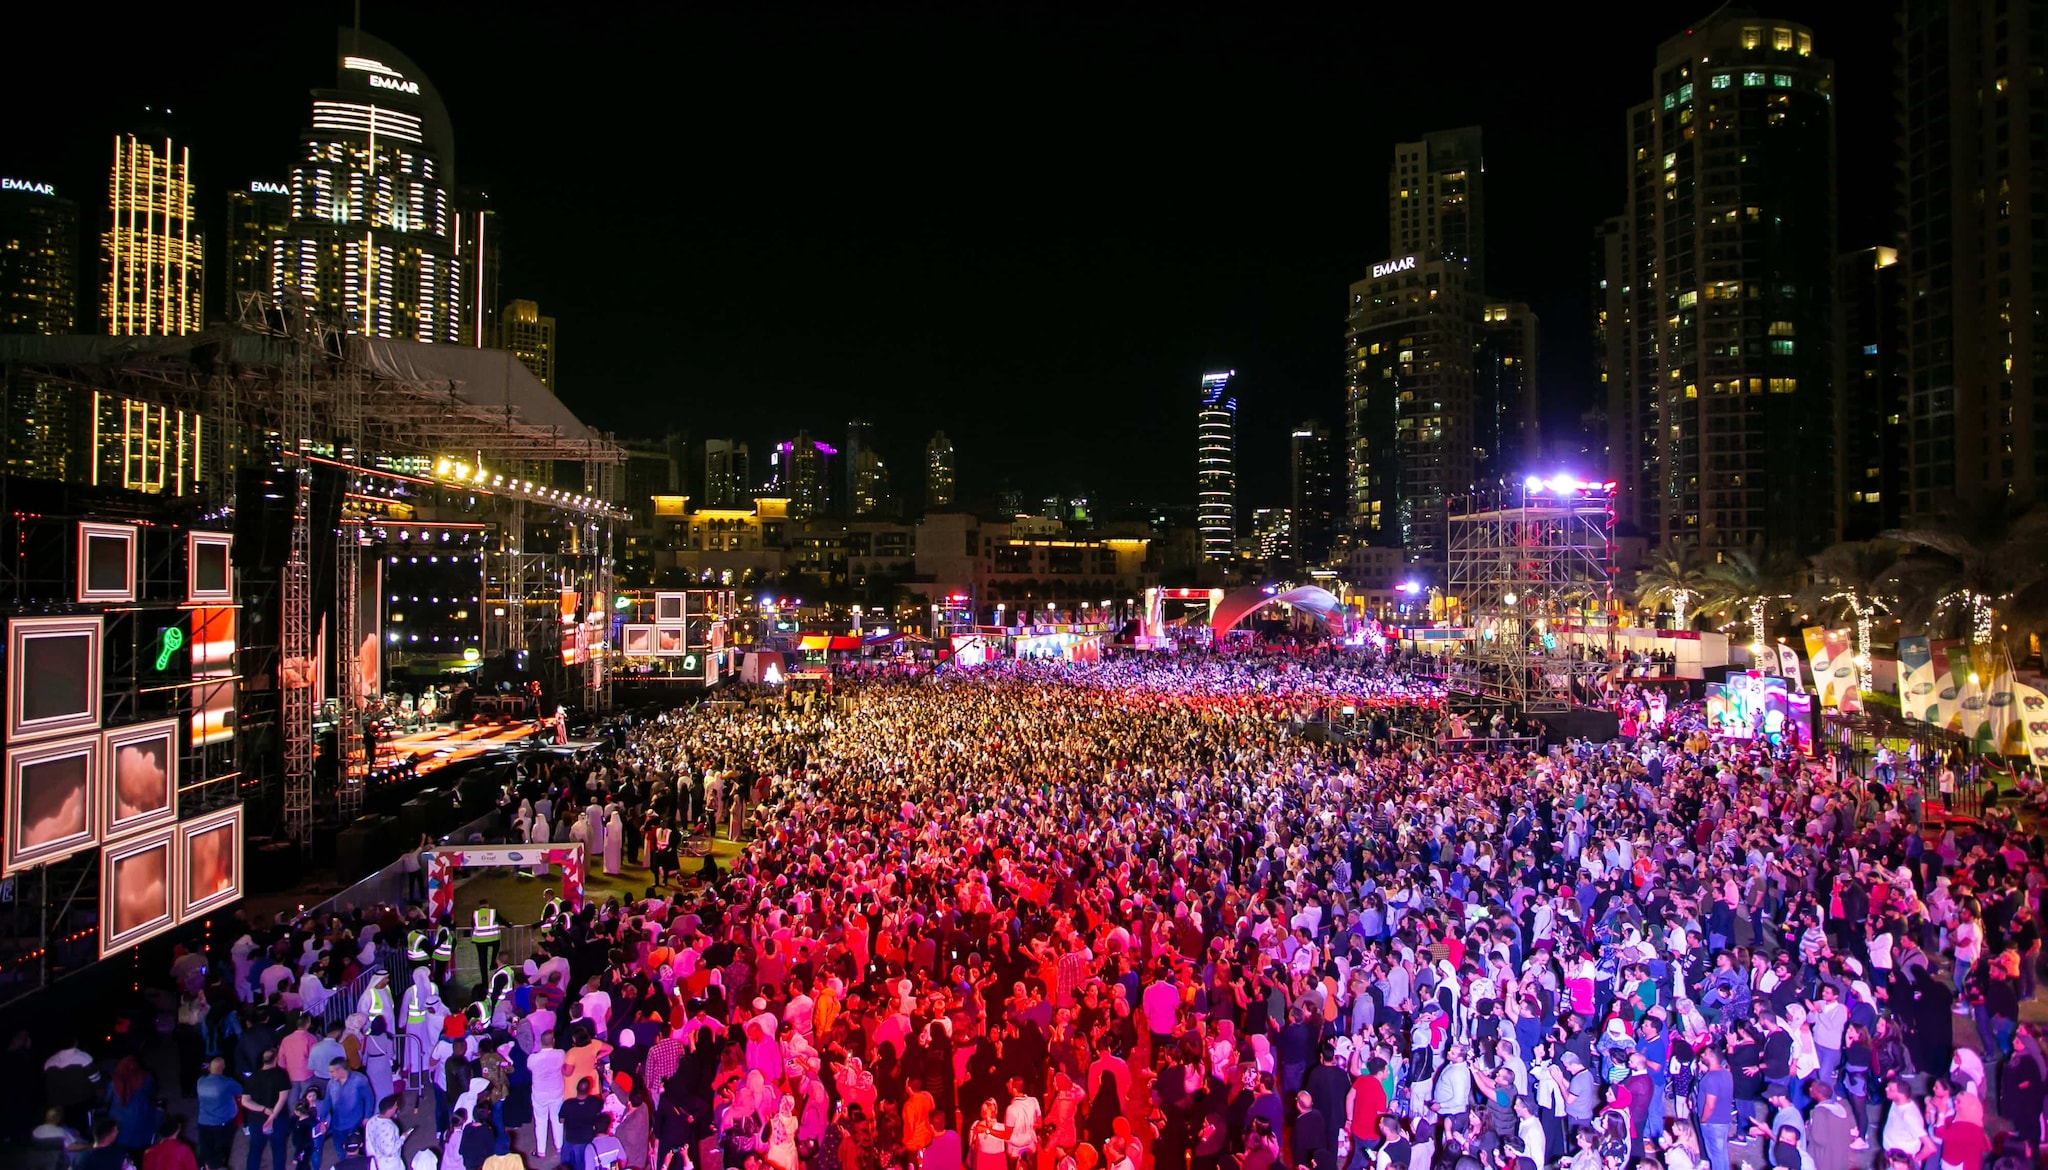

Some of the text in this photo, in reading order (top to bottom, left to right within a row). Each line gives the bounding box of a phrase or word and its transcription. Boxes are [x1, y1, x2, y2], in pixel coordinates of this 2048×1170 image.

[369, 74, 420, 95] EMAAR
[2, 178, 55, 196] EMAAR
[251, 181, 290, 195] EMAA
[1373, 256, 1415, 278] EMAAR
